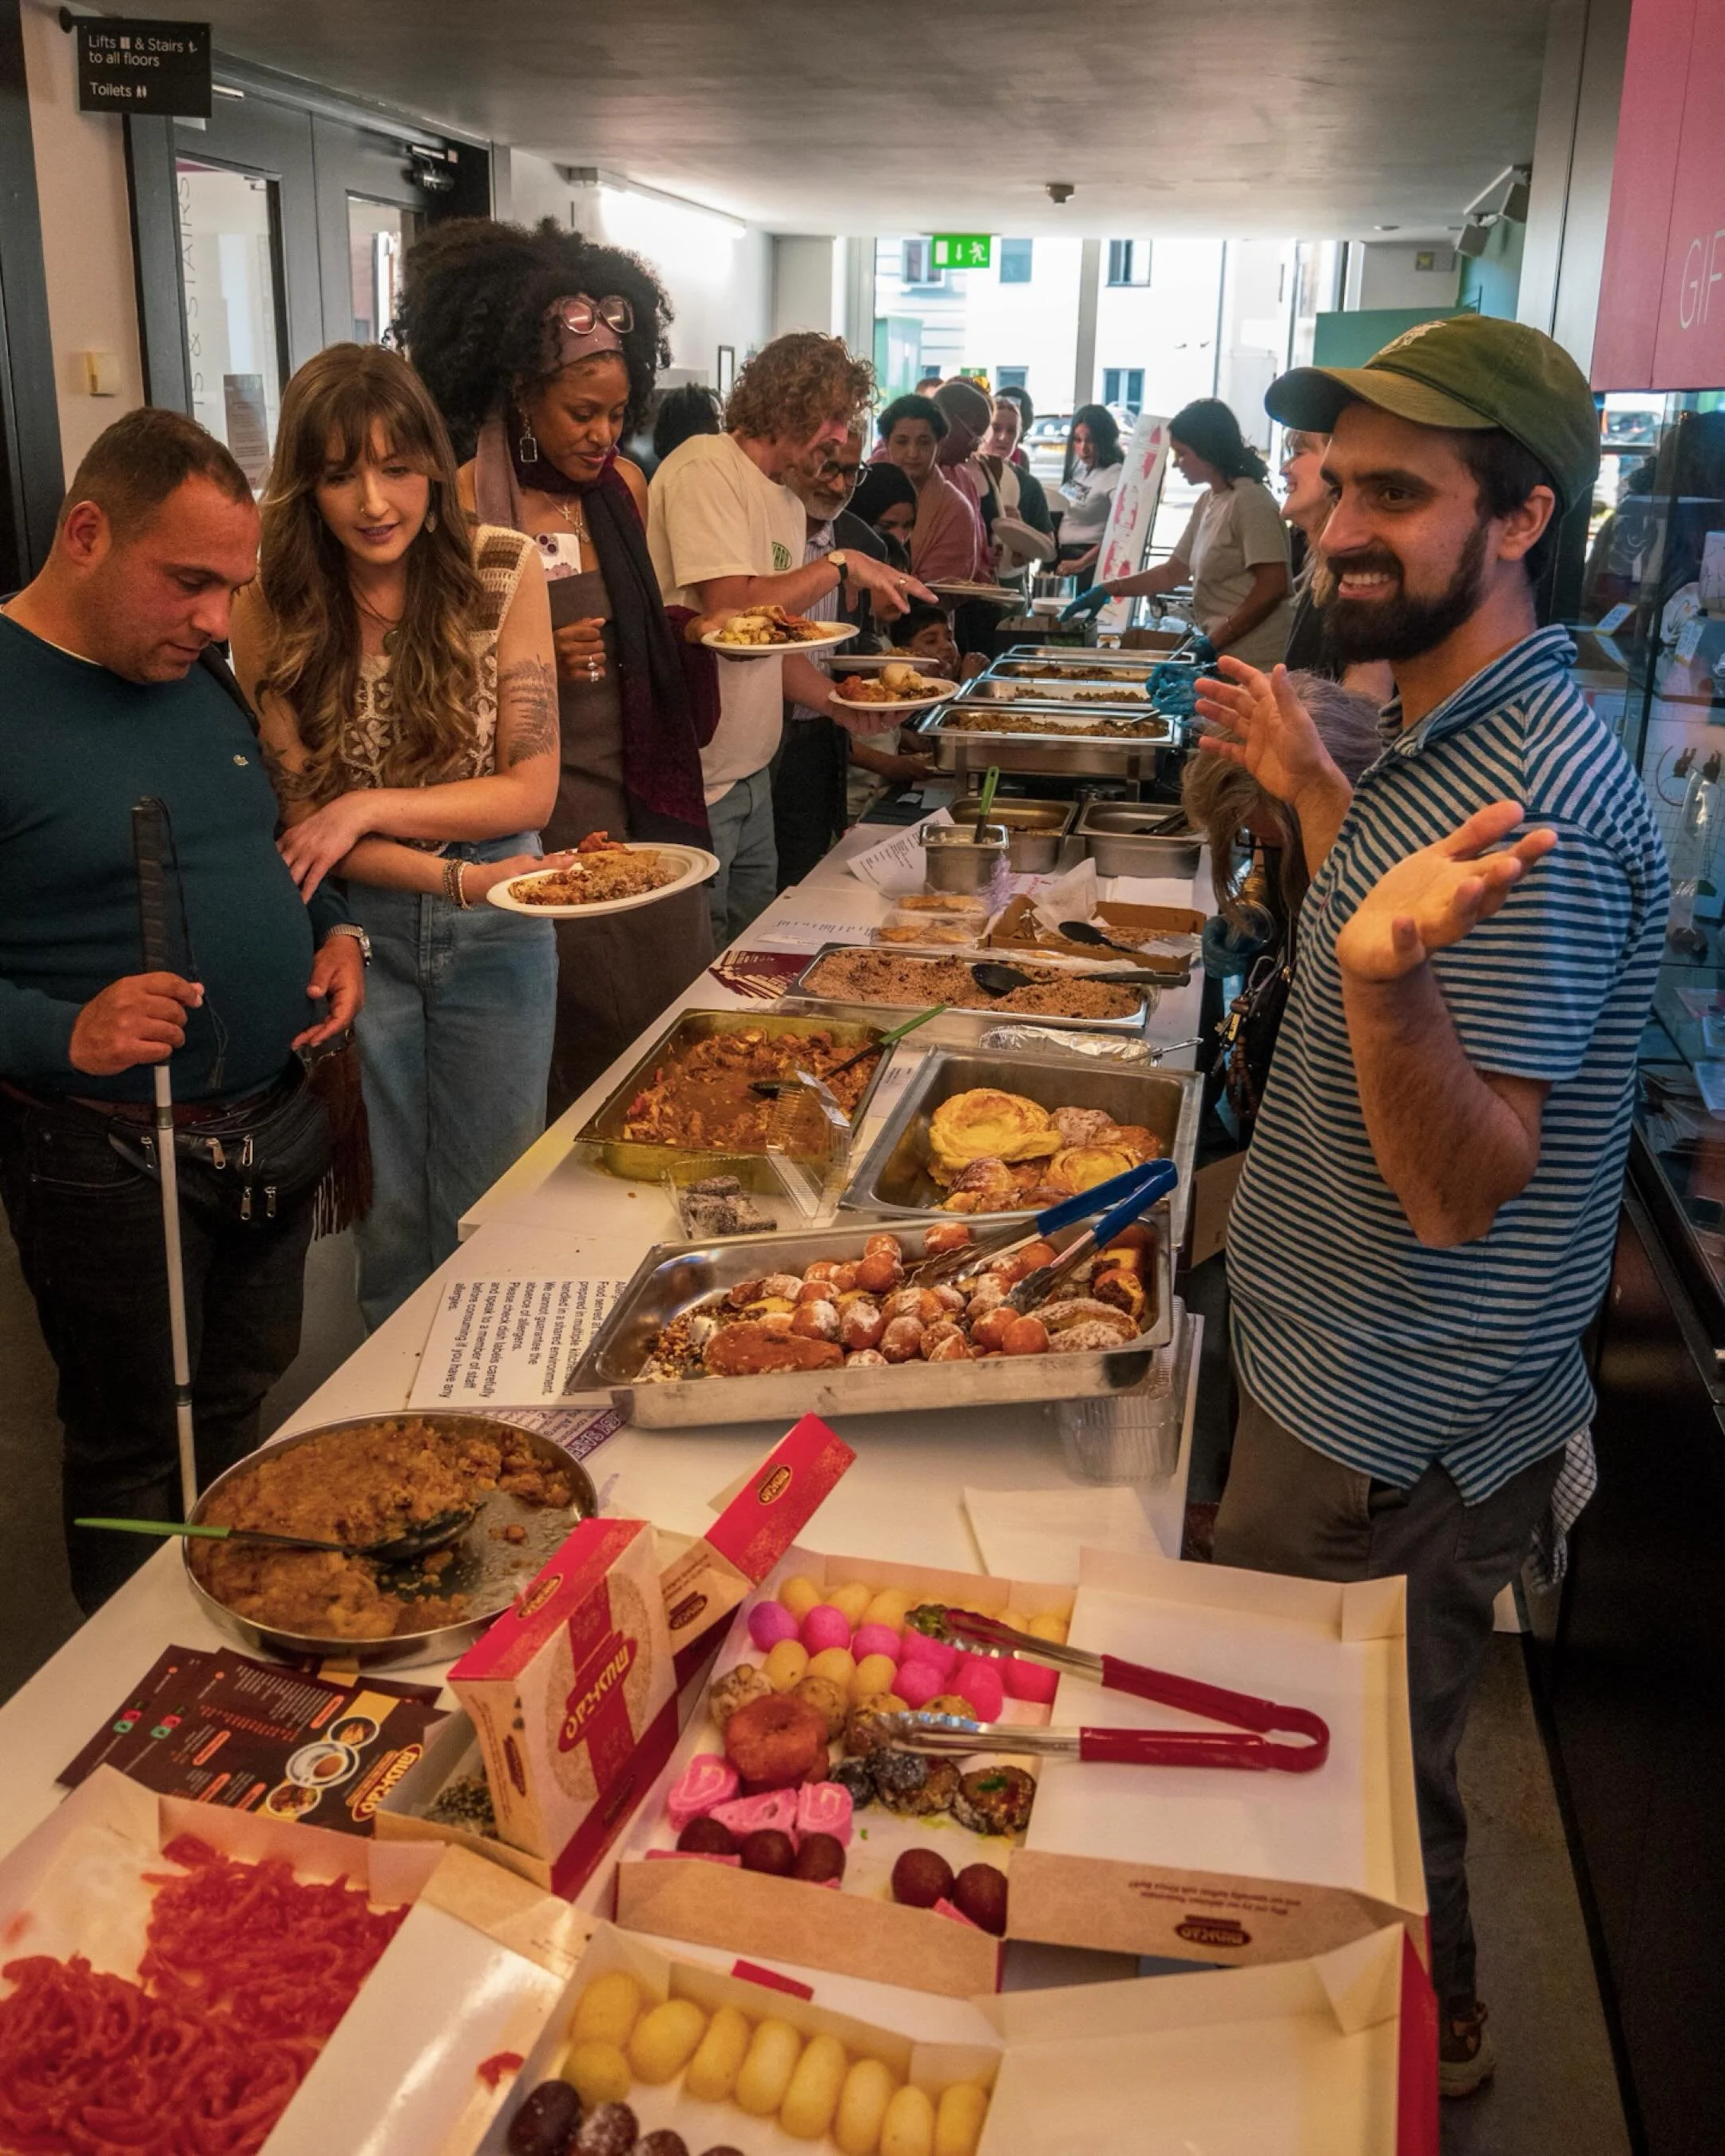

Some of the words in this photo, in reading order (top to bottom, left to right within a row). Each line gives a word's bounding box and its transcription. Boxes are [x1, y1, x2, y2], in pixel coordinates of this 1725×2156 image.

[89, 35, 116, 49] Lifts
[134, 38, 145, 50] &
[148, 38, 184, 53] Stairs
[89, 51, 102, 64] to
[105, 51, 120, 64] all
[124, 51, 161, 67] floors
[89, 82, 133, 97] Toilets
[448, 1282, 466, 1311] allergies.
[469, 1282, 486, 1303] before
[489, 1282, 500, 1294] and
[505, 1282, 521, 1303] Please
[521, 1281, 536, 1308] absence
[544, 1281, 557, 1292] We
[559, 1281, 575, 1307] handled
[576, 1281, 589, 1310] prepared
[597, 1281, 609, 1298] Food
[484, 1295, 497, 1314] speak
[500, 1303, 513, 1324] check
[538, 1292, 552, 1316] cannot
[593, 1298, 605, 1320] served
[455, 1303, 476, 1342] consuming
[569, 1318, 584, 1346] multiple
[495, 1326, 508, 1342] dish
[512, 1318, 530, 1352] allergens.
[530, 1316, 546, 1352] guarantee
[551, 1322, 566, 1346] shared
[450, 1348, 463, 1362] you
[471, 1330, 487, 1361] member
[490, 1342, 506, 1364] labels
[527, 1353, 541, 1365] the
[446, 1362, 463, 1383] have
[463, 1370, 479, 1389] staff
[479, 1365, 498, 1398] carefully
[541, 1346, 561, 1396] environment.
[438, 1383, 454, 1398] any
